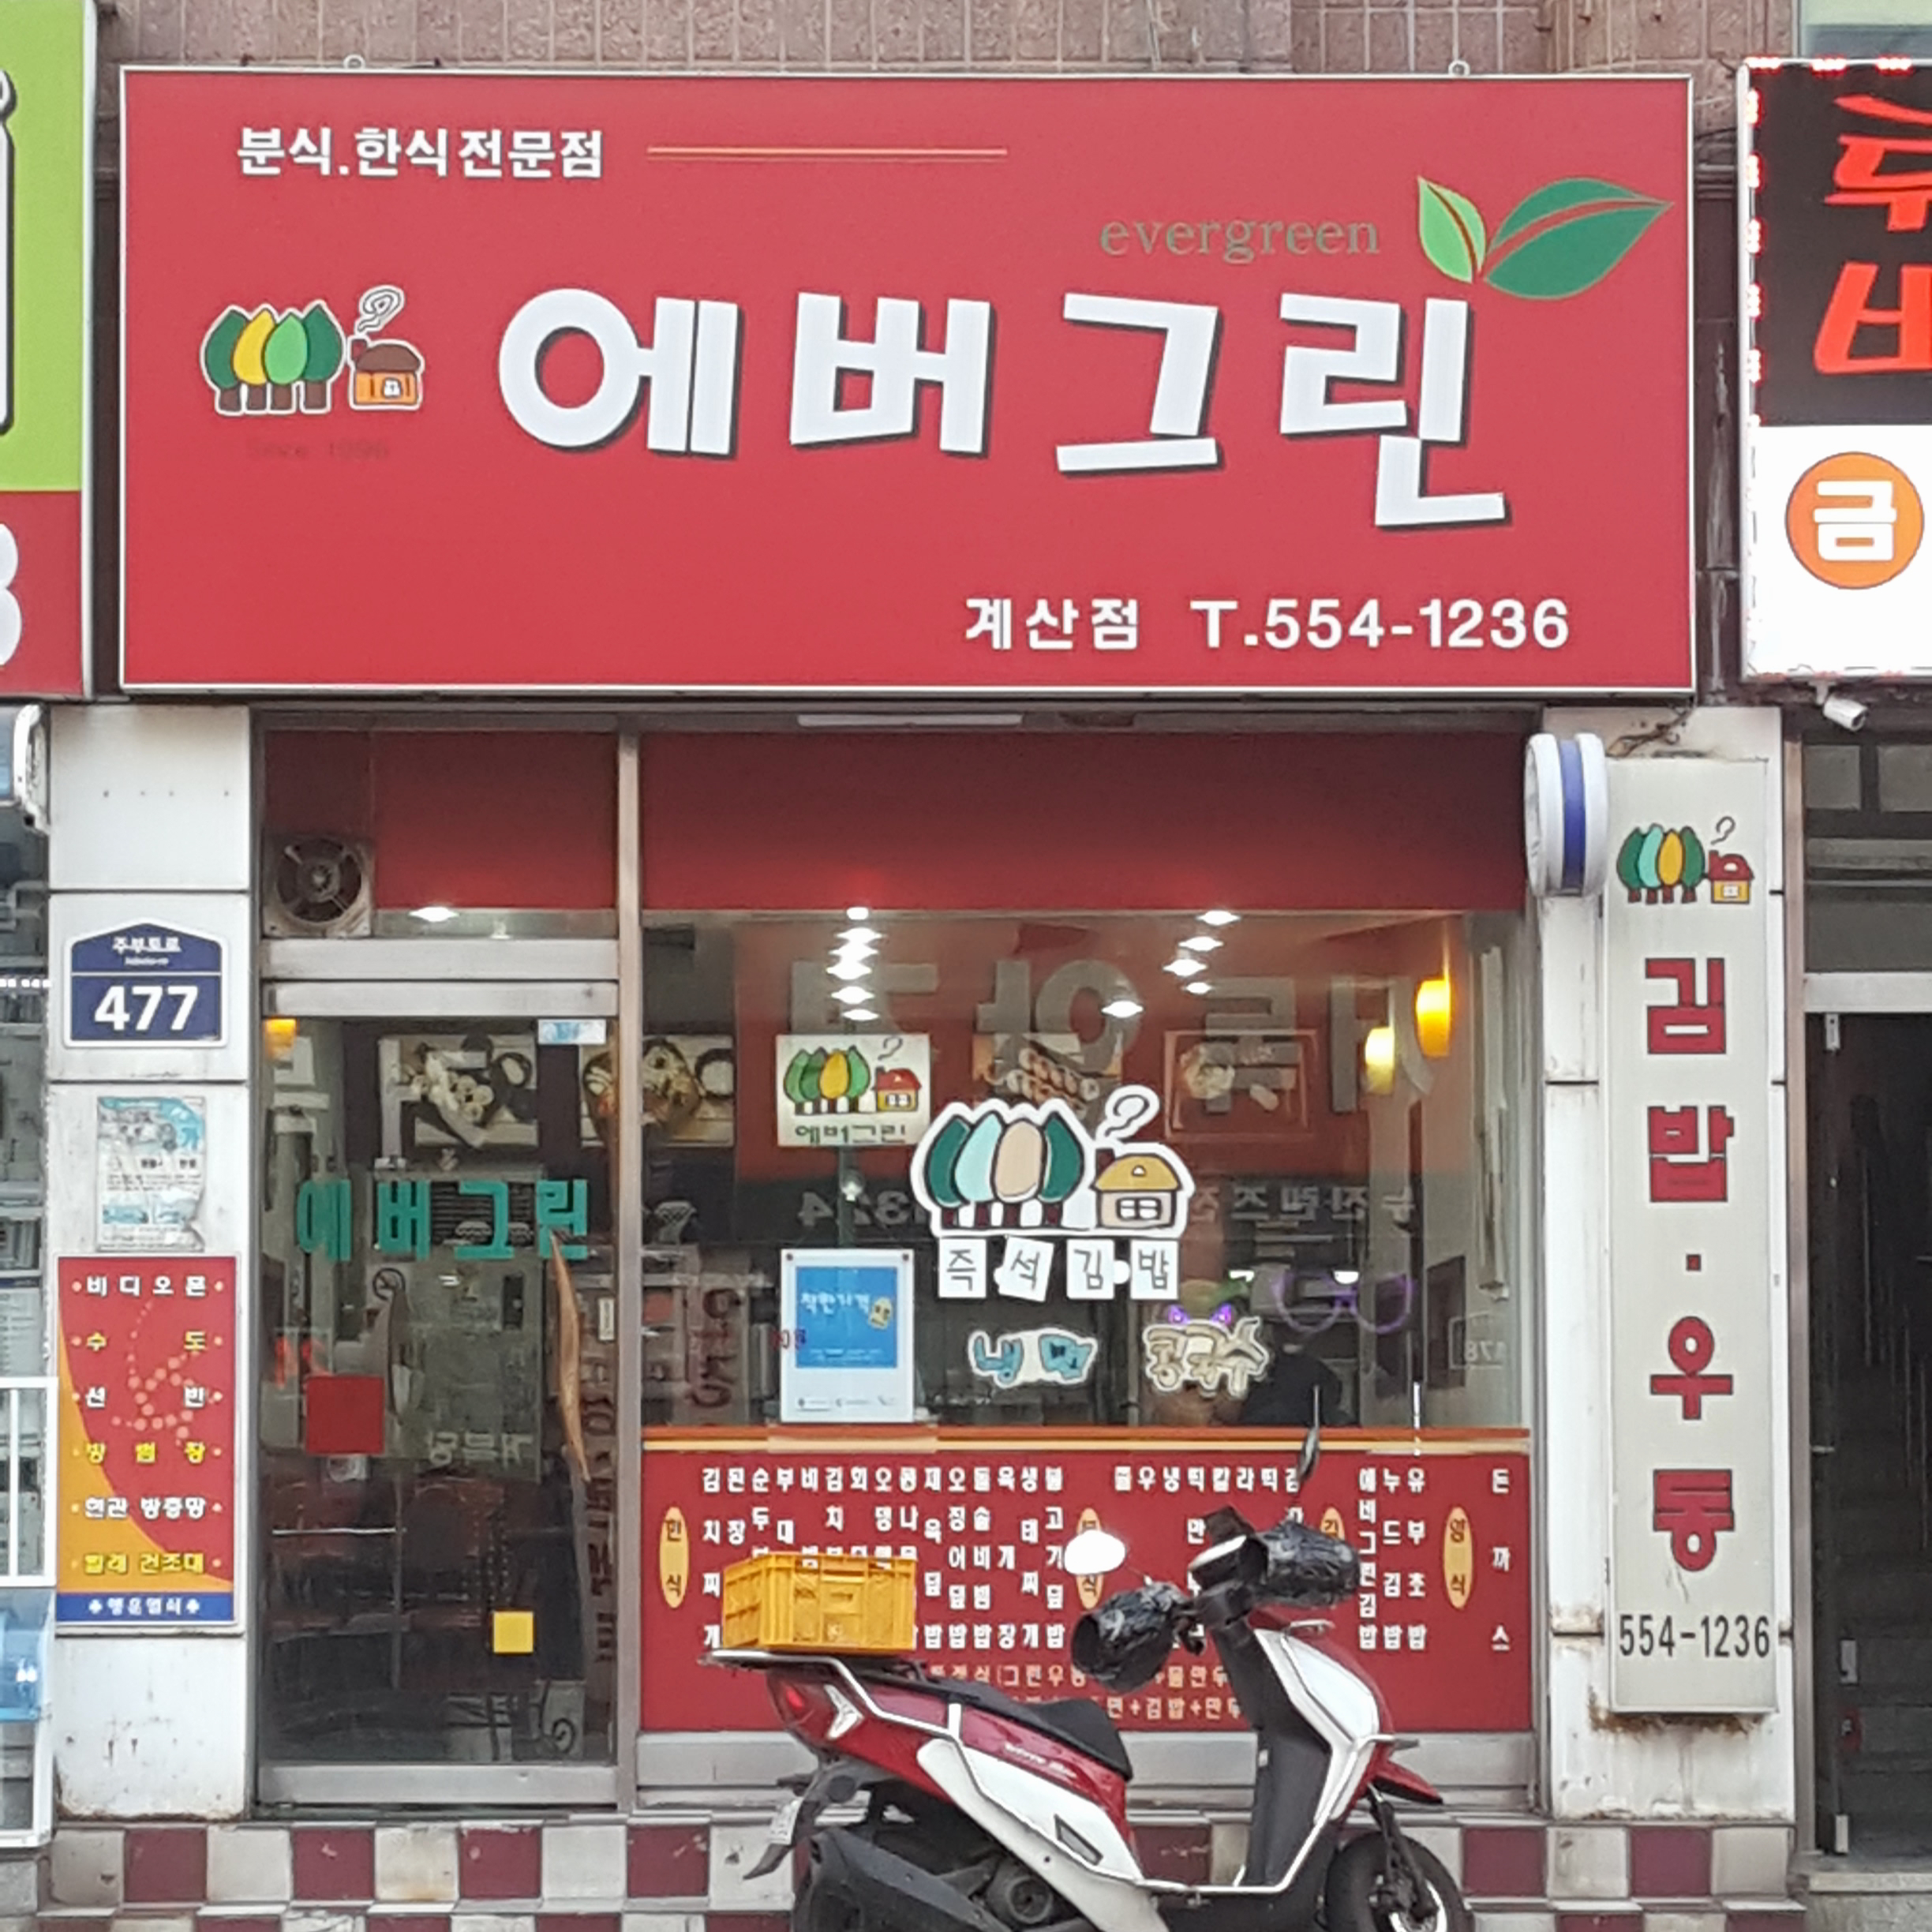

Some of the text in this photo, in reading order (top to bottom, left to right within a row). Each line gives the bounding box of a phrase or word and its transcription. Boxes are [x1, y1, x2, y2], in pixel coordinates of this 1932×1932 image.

[459, 128, 603, 179] 전문점
[1100, 219, 1380, 264] evergreen
[498, 287, 1507, 529] 에버그린
[964, 597, 1138, 651] 계산점
[94, 985, 199, 1032] 477
[794, 1123, 908, 1145] 에버그린
[295, 1178, 589, 1261] 에버그린
[86, 1275, 207, 1297] 비디오폰
[140, 1496, 208, 1521] 방충망
[140, 1552, 205, 1574] 건조대
[1619, 1614, 1770, 1659] 554-1236
